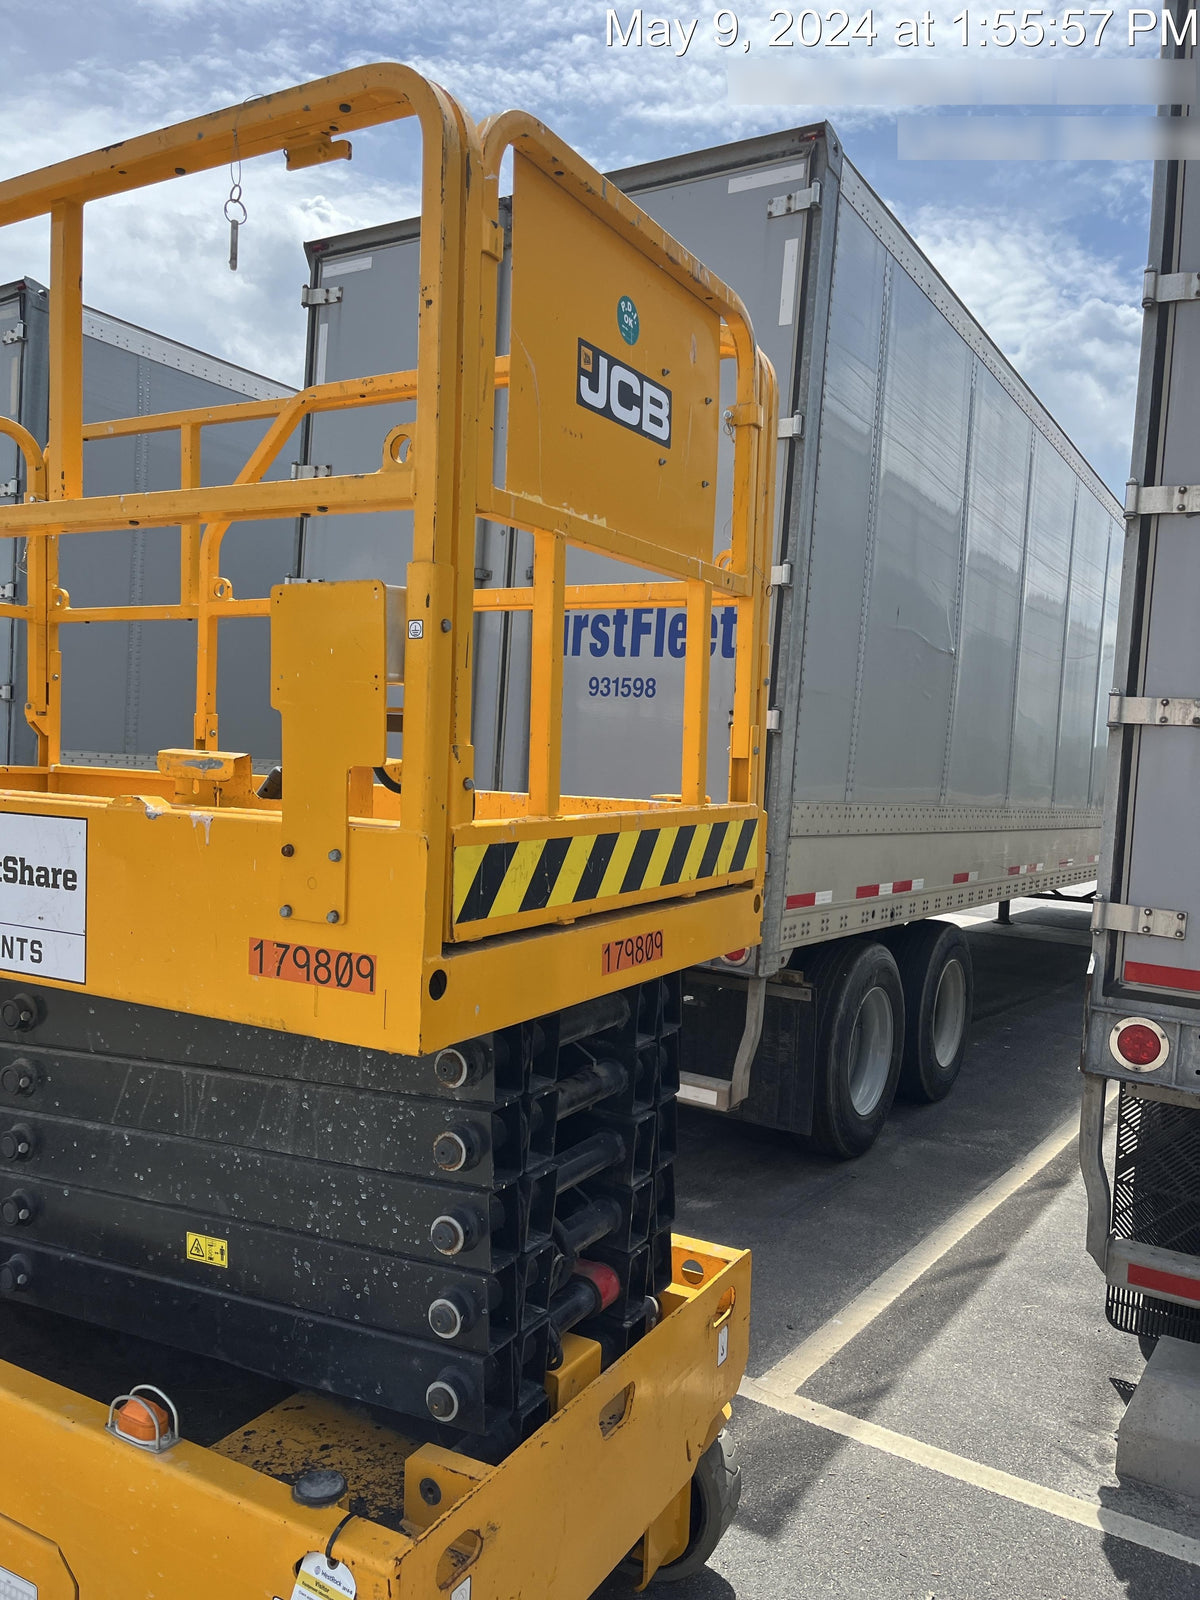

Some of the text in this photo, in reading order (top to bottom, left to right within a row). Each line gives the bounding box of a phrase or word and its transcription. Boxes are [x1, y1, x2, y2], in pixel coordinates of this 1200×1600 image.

[623, 313, 634, 329] OK
[579, 355, 671, 442] JCB
[588, 676, 657, 699] 931598
[0, 855, 78, 892] Share
[1, 934, 43, 964] NTS
[252, 939, 375, 993] 179809
[603, 930, 663, 973] 179809
